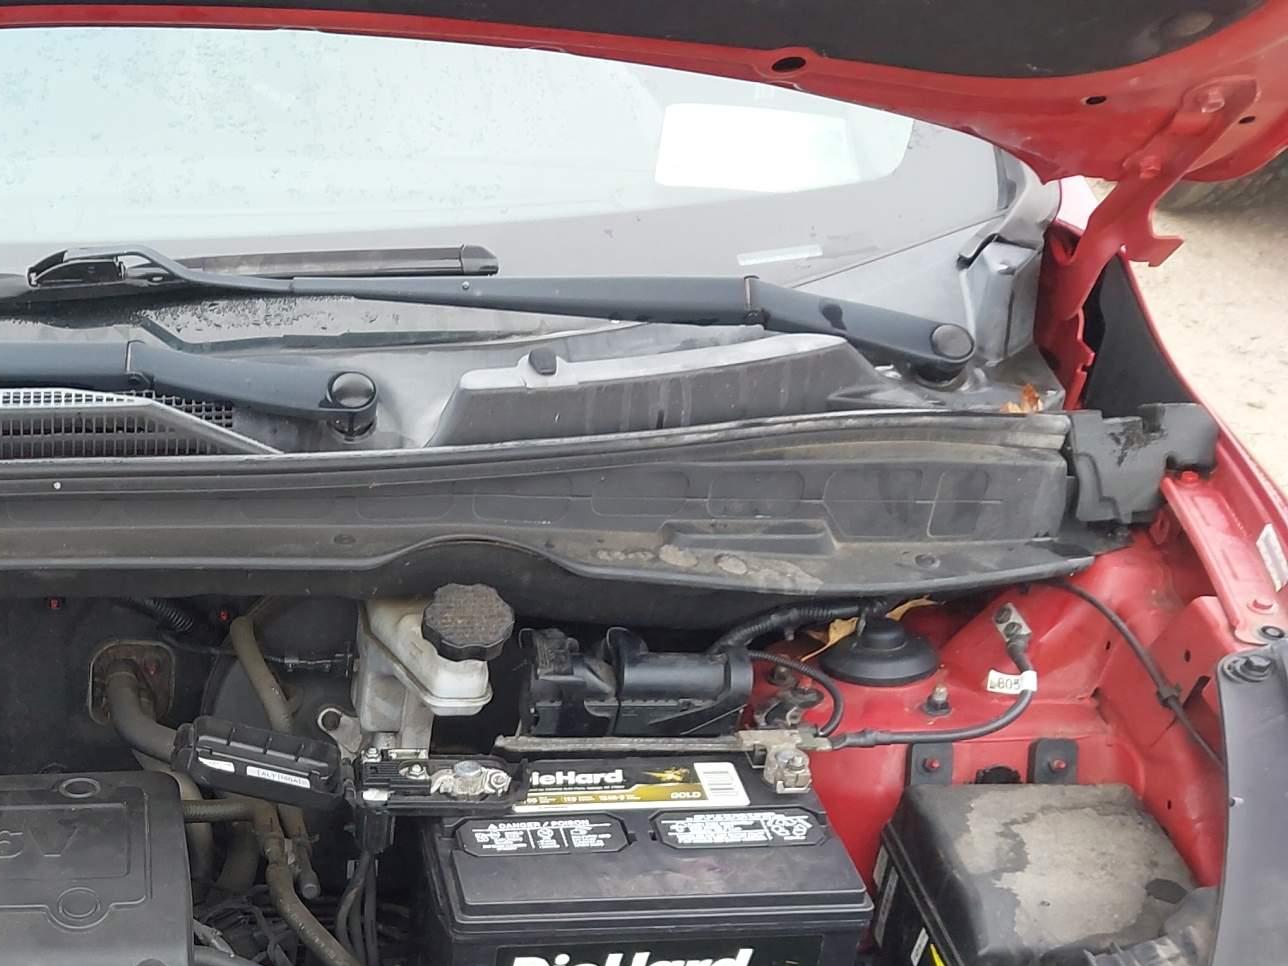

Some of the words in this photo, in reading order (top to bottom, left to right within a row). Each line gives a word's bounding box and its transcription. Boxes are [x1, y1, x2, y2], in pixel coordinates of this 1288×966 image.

[529, 769, 624, 786] ieHard
[670, 791, 702, 800] GOLD
[500, 822, 541, 830] DANGER
[550, 819, 590, 827] POISON
